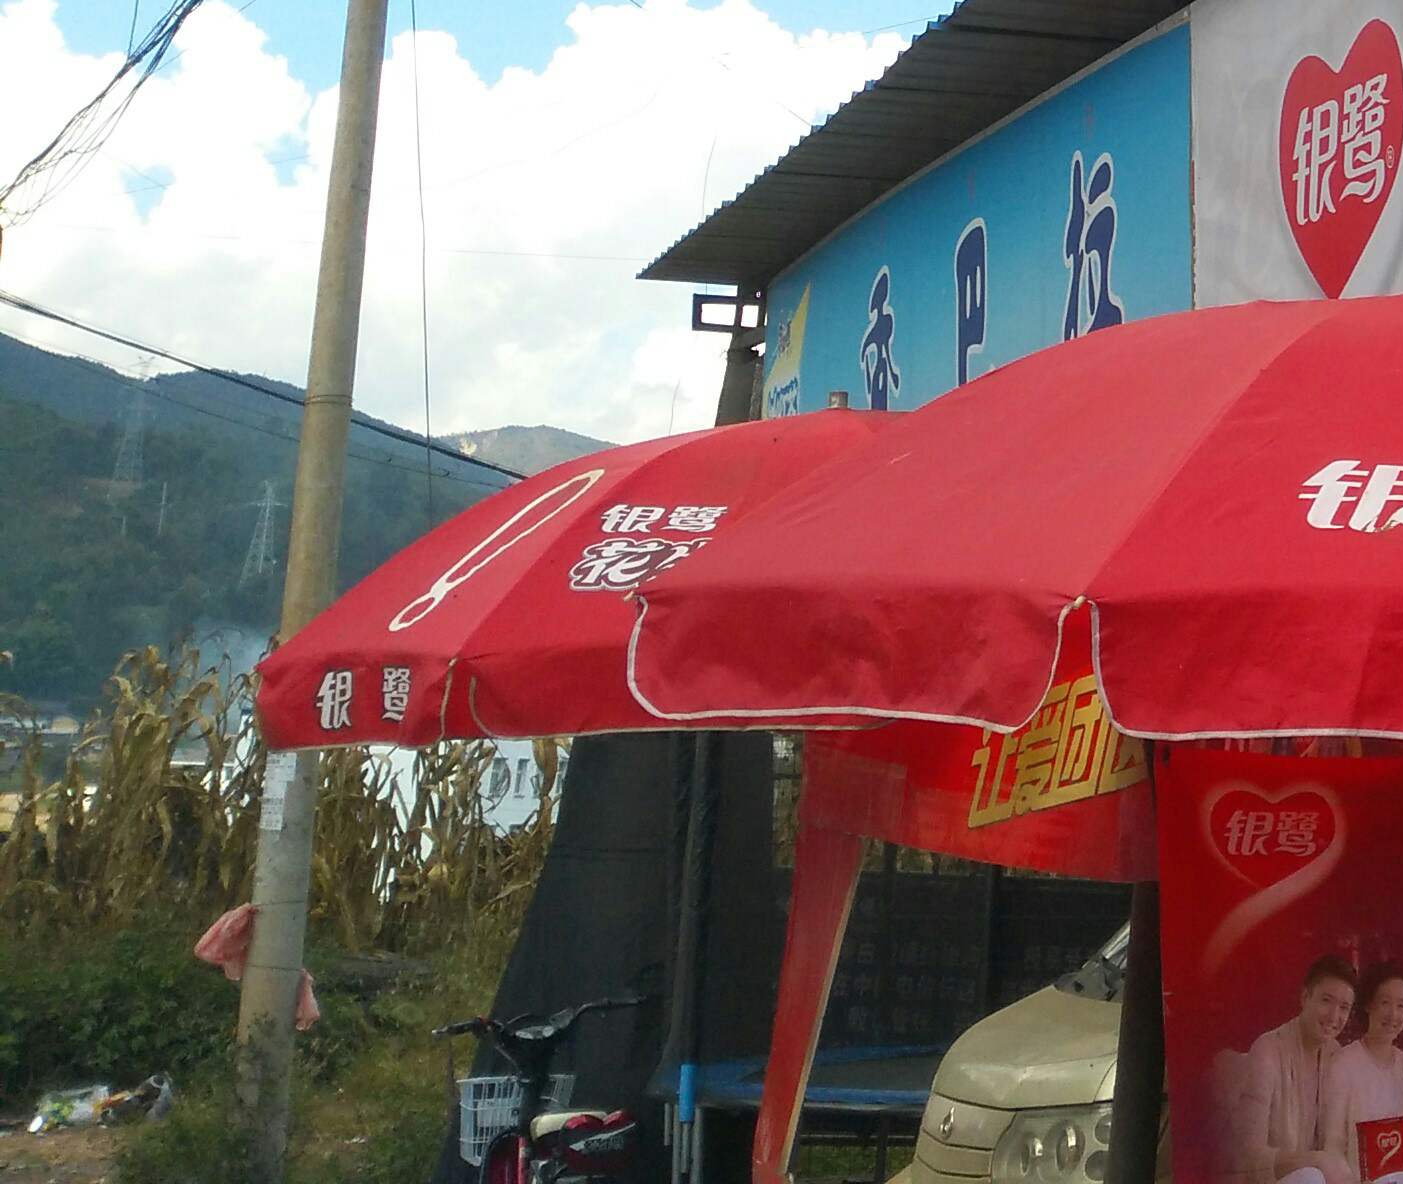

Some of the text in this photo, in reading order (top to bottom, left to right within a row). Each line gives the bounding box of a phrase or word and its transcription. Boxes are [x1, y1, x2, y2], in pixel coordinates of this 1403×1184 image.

[1292, 73, 1391, 226] 银鹭
[600, 503, 728, 533] 银鹭
[315, 667, 412, 730] 银鹭
[1223, 808, 1321, 858] 银鹭
